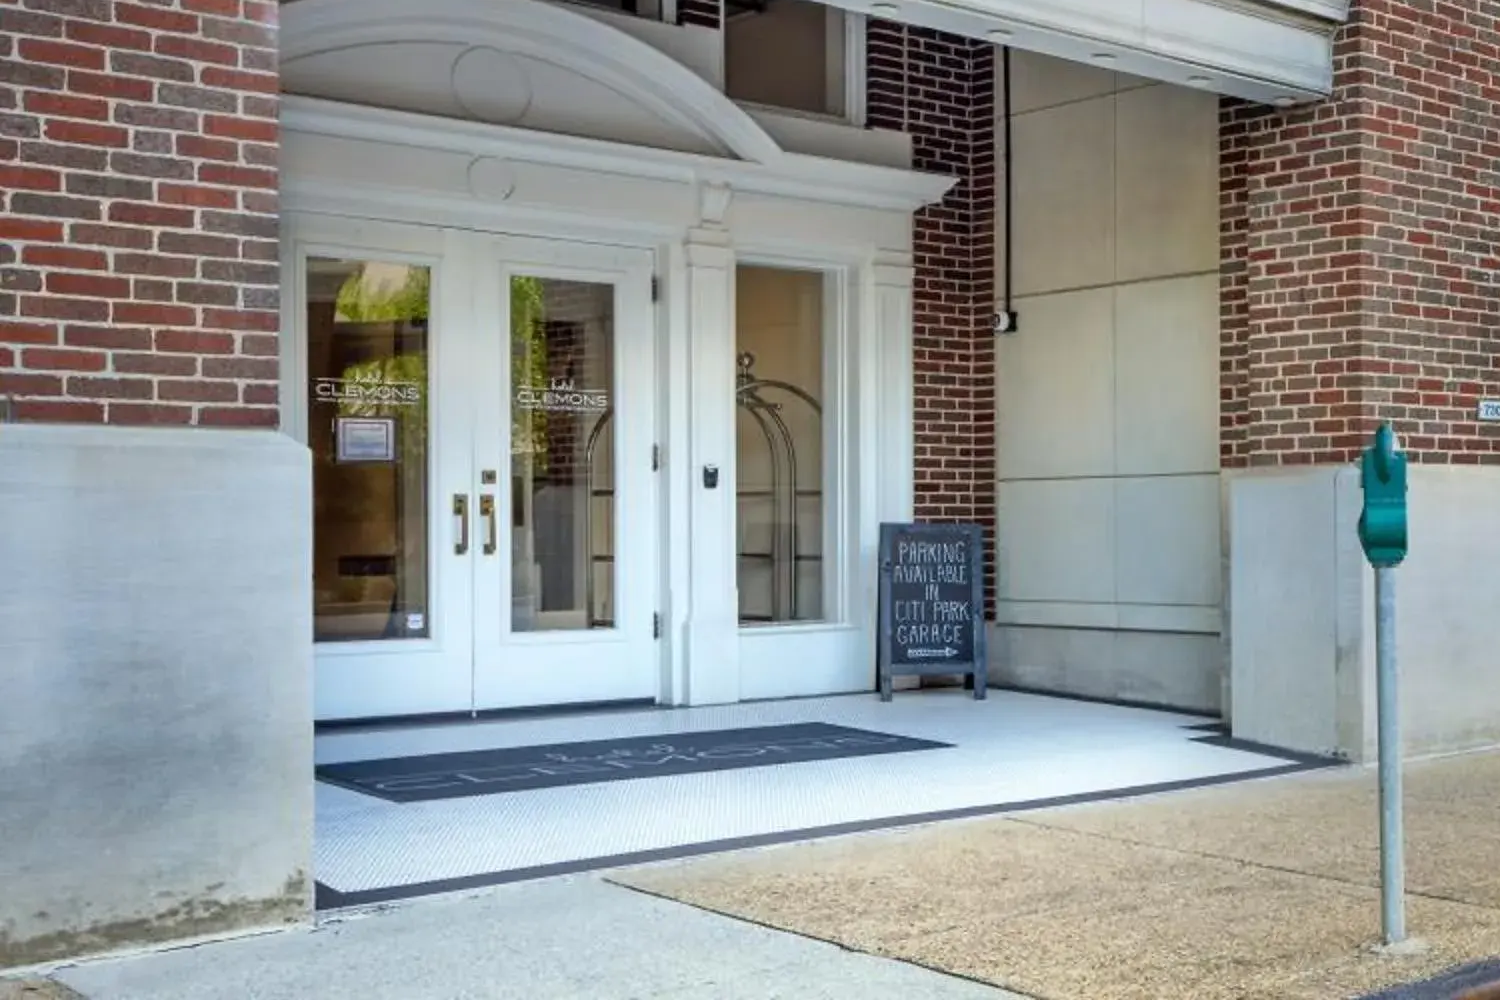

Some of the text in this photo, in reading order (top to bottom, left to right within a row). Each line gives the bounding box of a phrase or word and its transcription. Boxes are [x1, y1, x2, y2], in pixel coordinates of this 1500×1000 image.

[315, 382, 419, 400] CLEMONS
[899, 541, 965, 563] PARKING
[893, 565, 968, 584] AVAILABLE
[925, 585, 940, 601] IN
[933, 601, 970, 621] PARK
